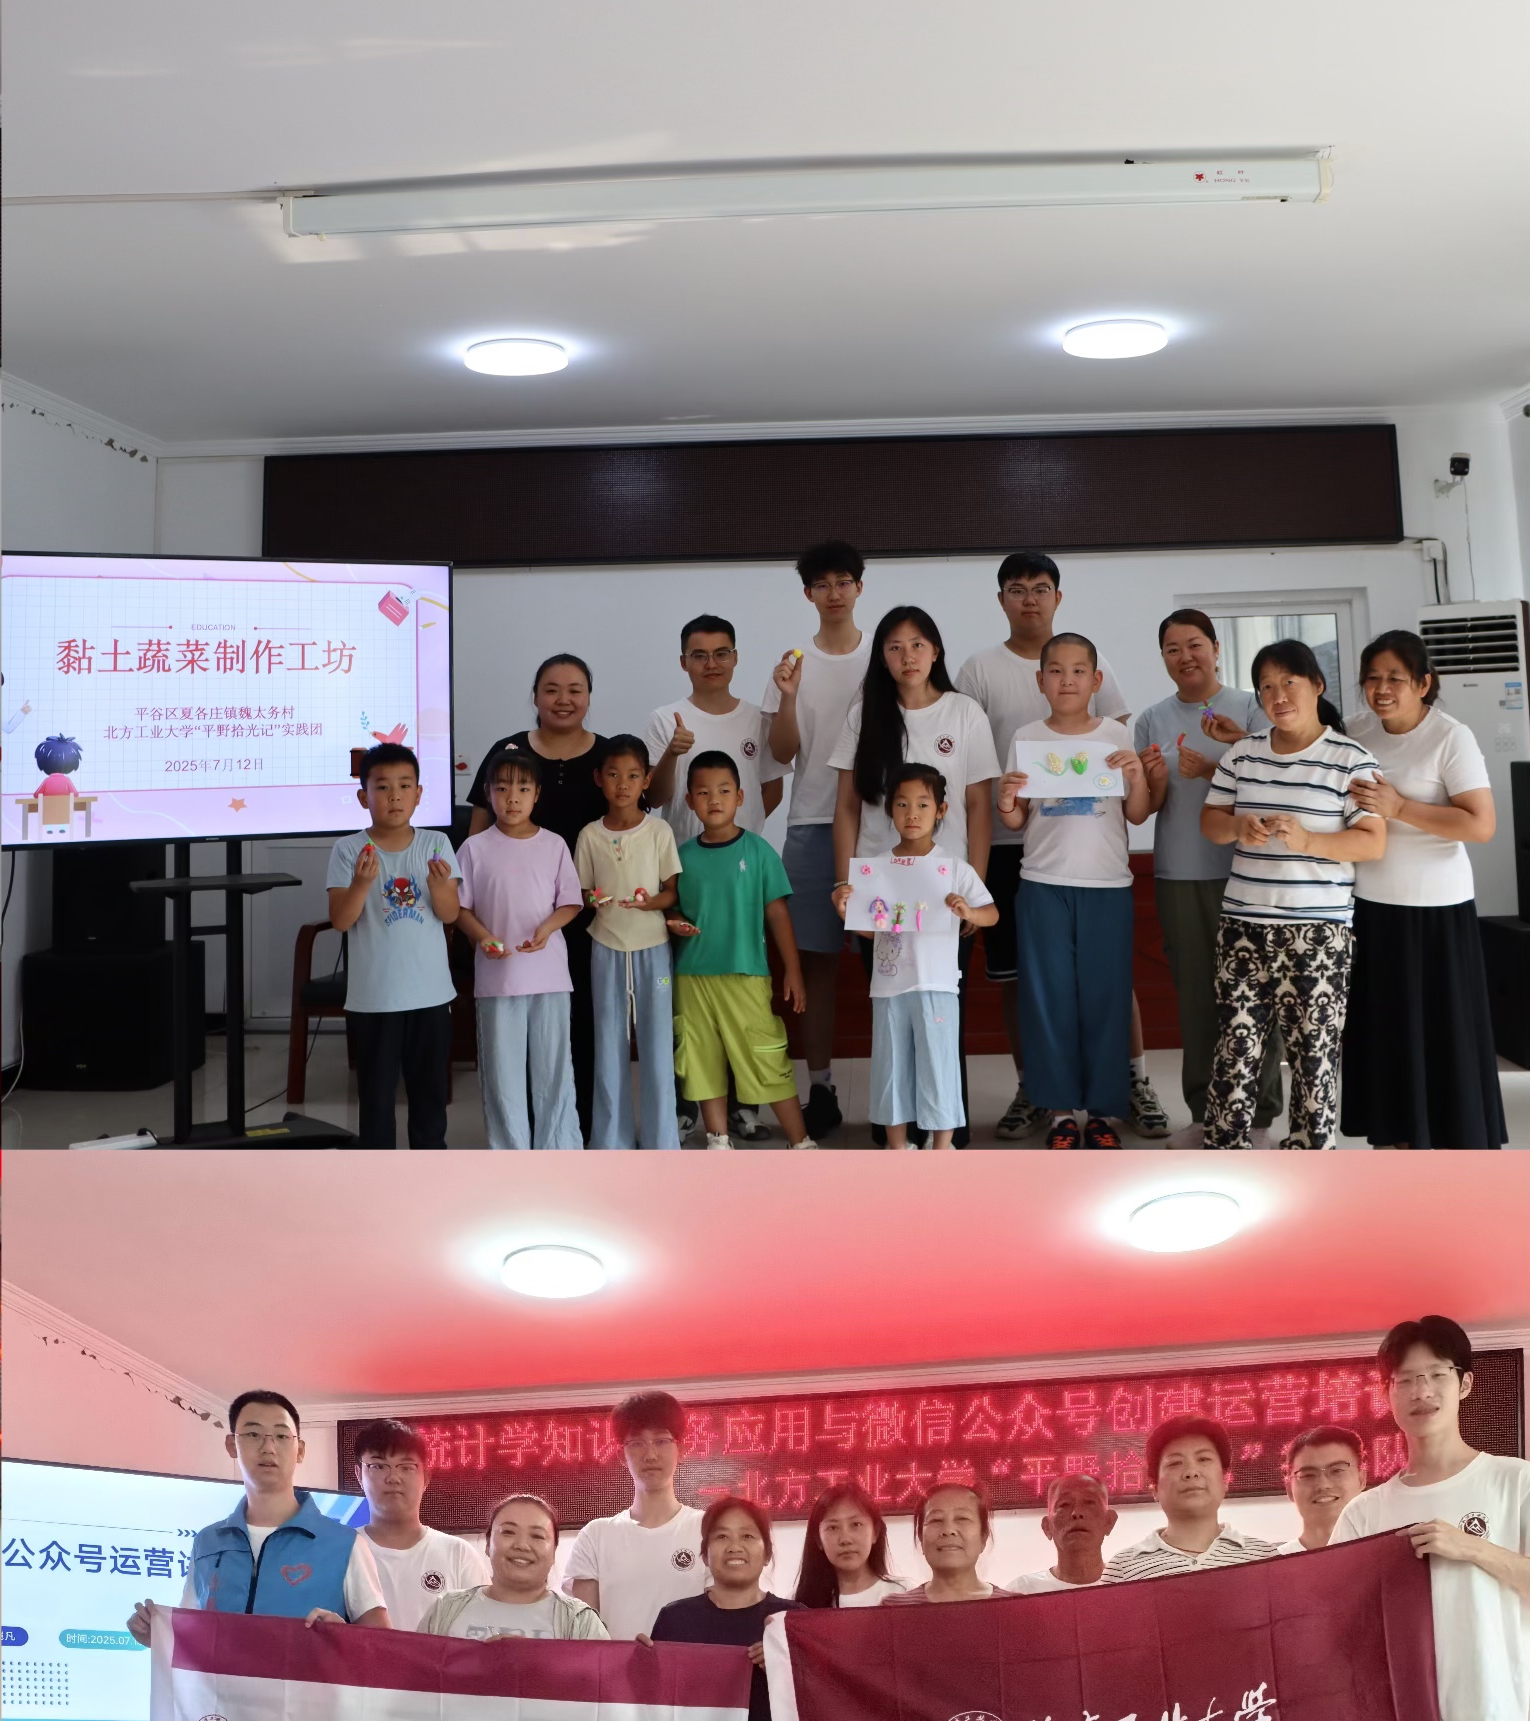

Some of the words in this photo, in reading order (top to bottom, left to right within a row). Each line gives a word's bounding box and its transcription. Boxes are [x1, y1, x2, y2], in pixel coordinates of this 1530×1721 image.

[191, 623, 236, 631] EDUCATION
[56, 637, 358, 675] 黏土蔬菜制作工坊
[135, 705, 295, 722] 平谷区夏各庄镇魏太务村
[165, 758, 264, 773] 2025年7月12日
[384, 908, 425, 926] SPIDERMAN
